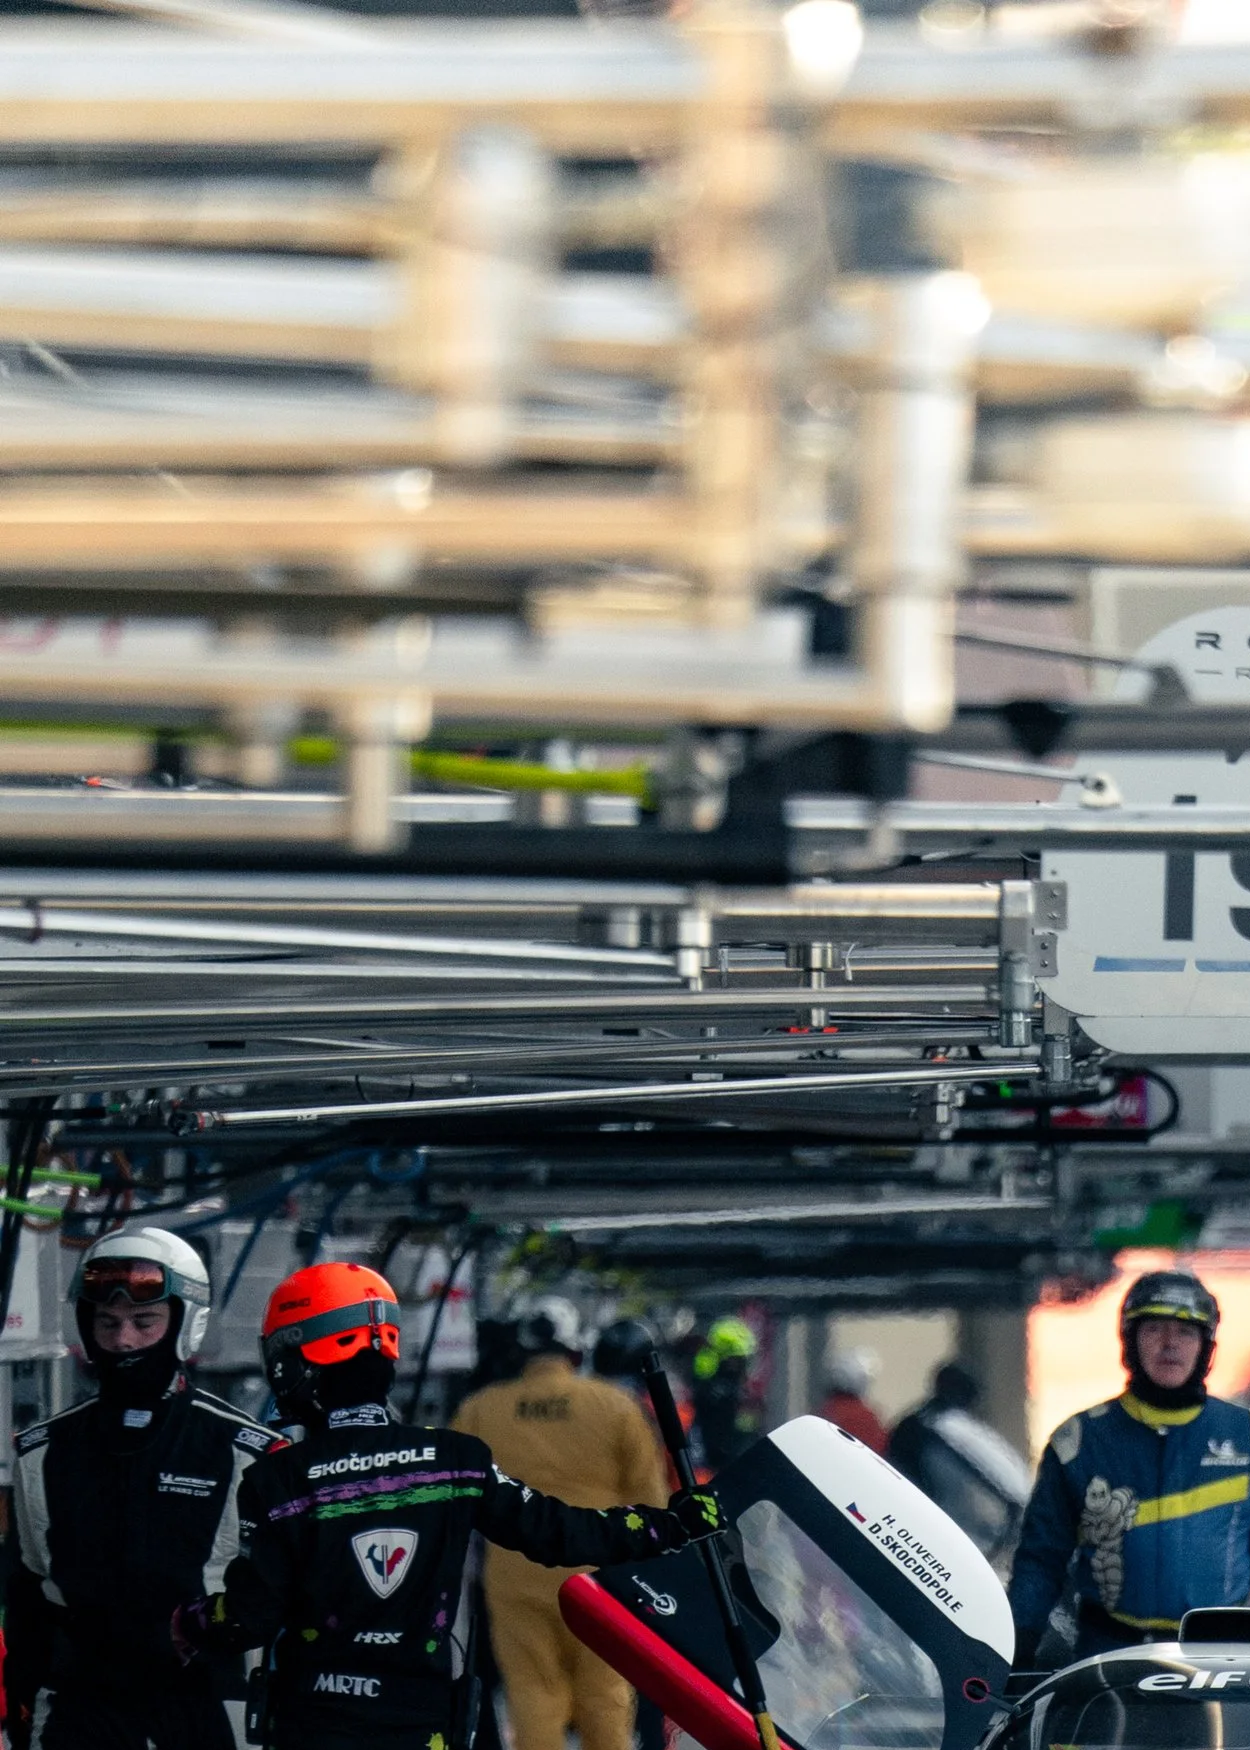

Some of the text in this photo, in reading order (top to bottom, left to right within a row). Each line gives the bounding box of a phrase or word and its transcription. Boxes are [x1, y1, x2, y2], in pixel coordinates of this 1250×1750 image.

[307, 1447, 436, 1479] SKOČDOPOLE
[868, 1522, 963, 1613] D.SKOCDOPOLE
[897, 1528, 953, 1582] OLIVEIRA
[353, 1631, 403, 1645] HRX
[313, 1673, 382, 1698] MRTC
[1138, 1670, 1246, 1691] elf
